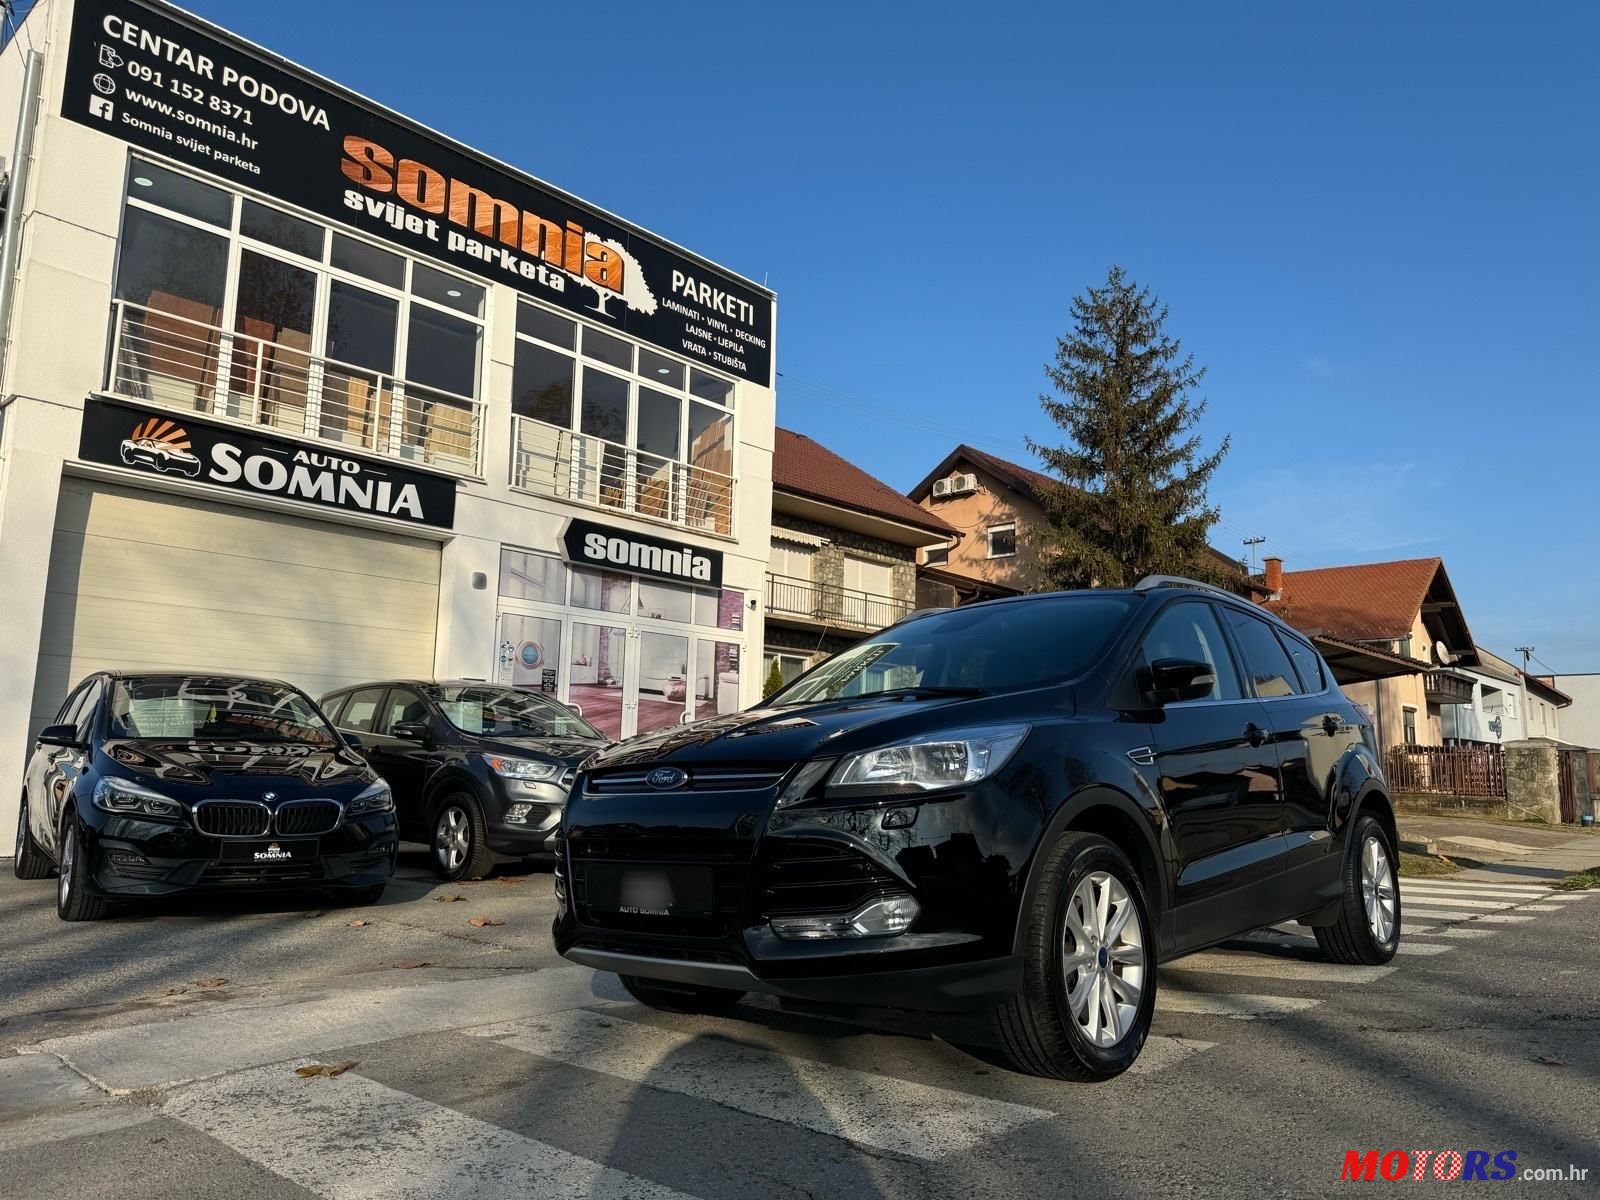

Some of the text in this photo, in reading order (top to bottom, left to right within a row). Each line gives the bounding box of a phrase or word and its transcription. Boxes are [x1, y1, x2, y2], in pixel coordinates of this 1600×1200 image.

[103, 15, 331, 131] CENTAR PODOVA
[127, 61, 253, 125] 091 152 8371
[121, 112, 261, 175] Somnia svijet parketa
[125, 87, 259, 150] www.somnia.hr
[340, 135, 625, 295] somnia
[343, 188, 567, 293] svijet parketa
[662, 297, 766, 349] LAMINATI VINYL DECKING
[672, 269, 754, 326] PARKETI
[682, 338, 747, 372] VRATA STUBIŠTA
[685, 323, 745, 355] LAJSNE LJEPILA
[208, 442, 425, 520] SOMNIA
[292, 449, 360, 475] AUTO
[583, 532, 712, 581] somnia
[651, 770, 676, 784] Ford
[253, 850, 292, 859] SOMNIA
